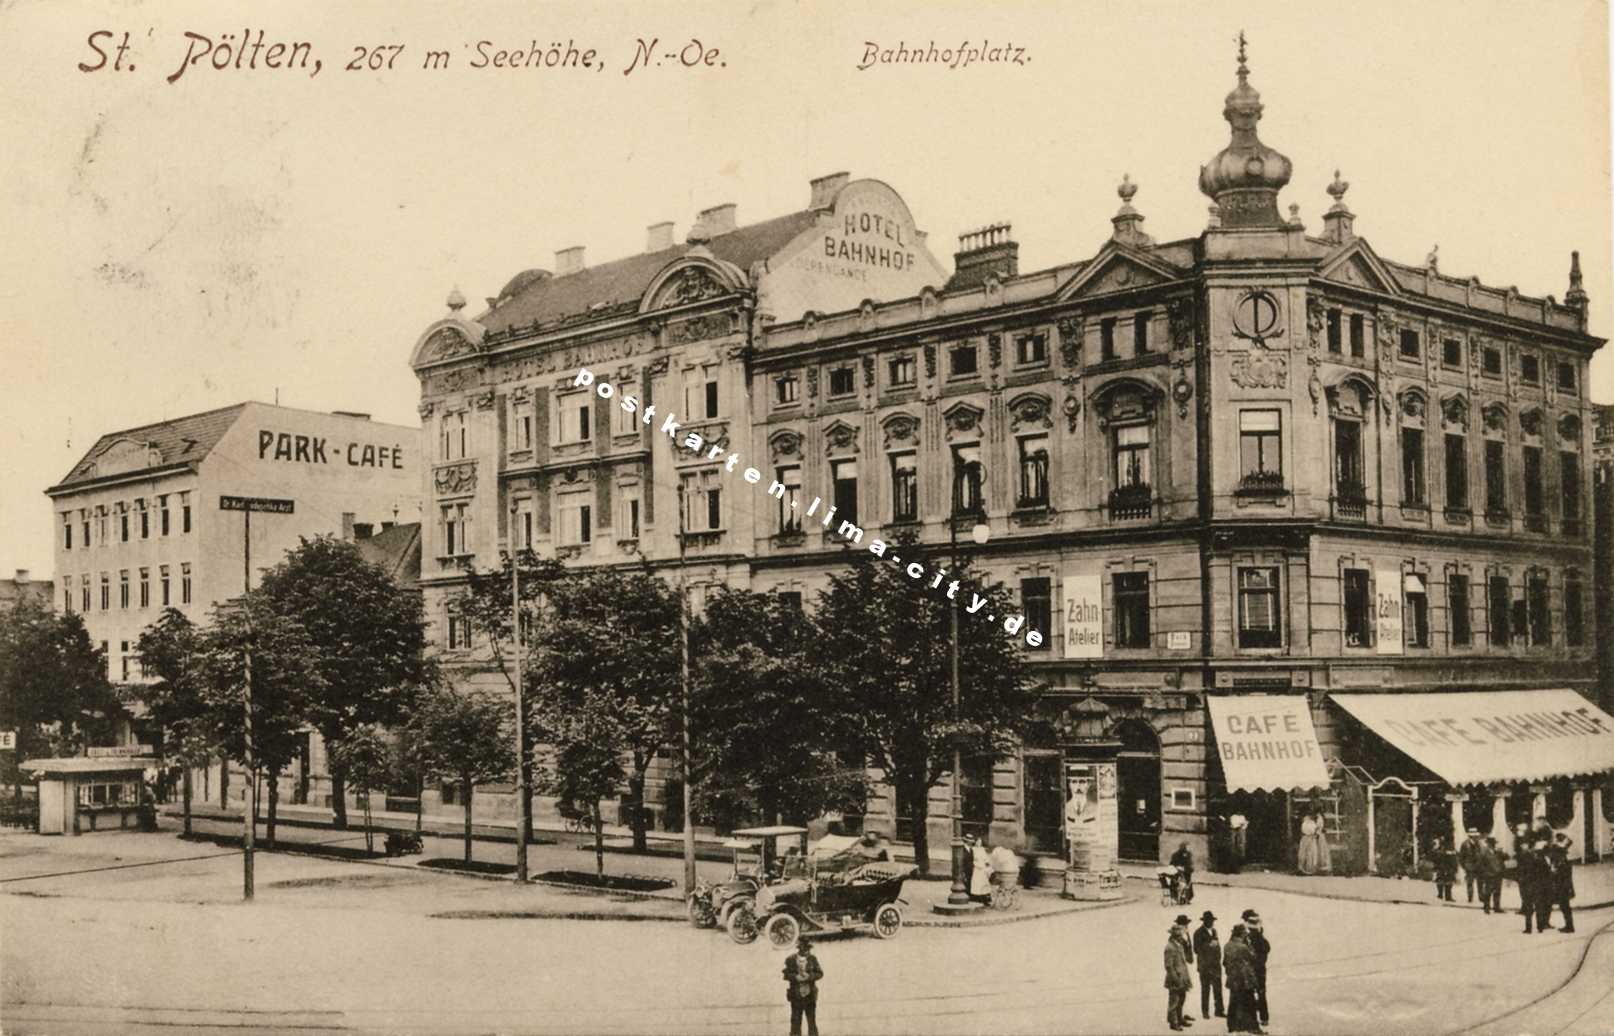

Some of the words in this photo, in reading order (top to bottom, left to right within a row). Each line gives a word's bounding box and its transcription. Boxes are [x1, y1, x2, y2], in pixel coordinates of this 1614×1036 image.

[845, 213, 904, 248] HOTEL
[825, 236, 915, 270] BAHNHOF
[1067, 599, 1099, 623] Zahn
[1068, 627, 1100, 645] Atelier
[1471, 707, 1611, 743] BAHNHOF
[1221, 740, 1314, 761] BAHNHOF
